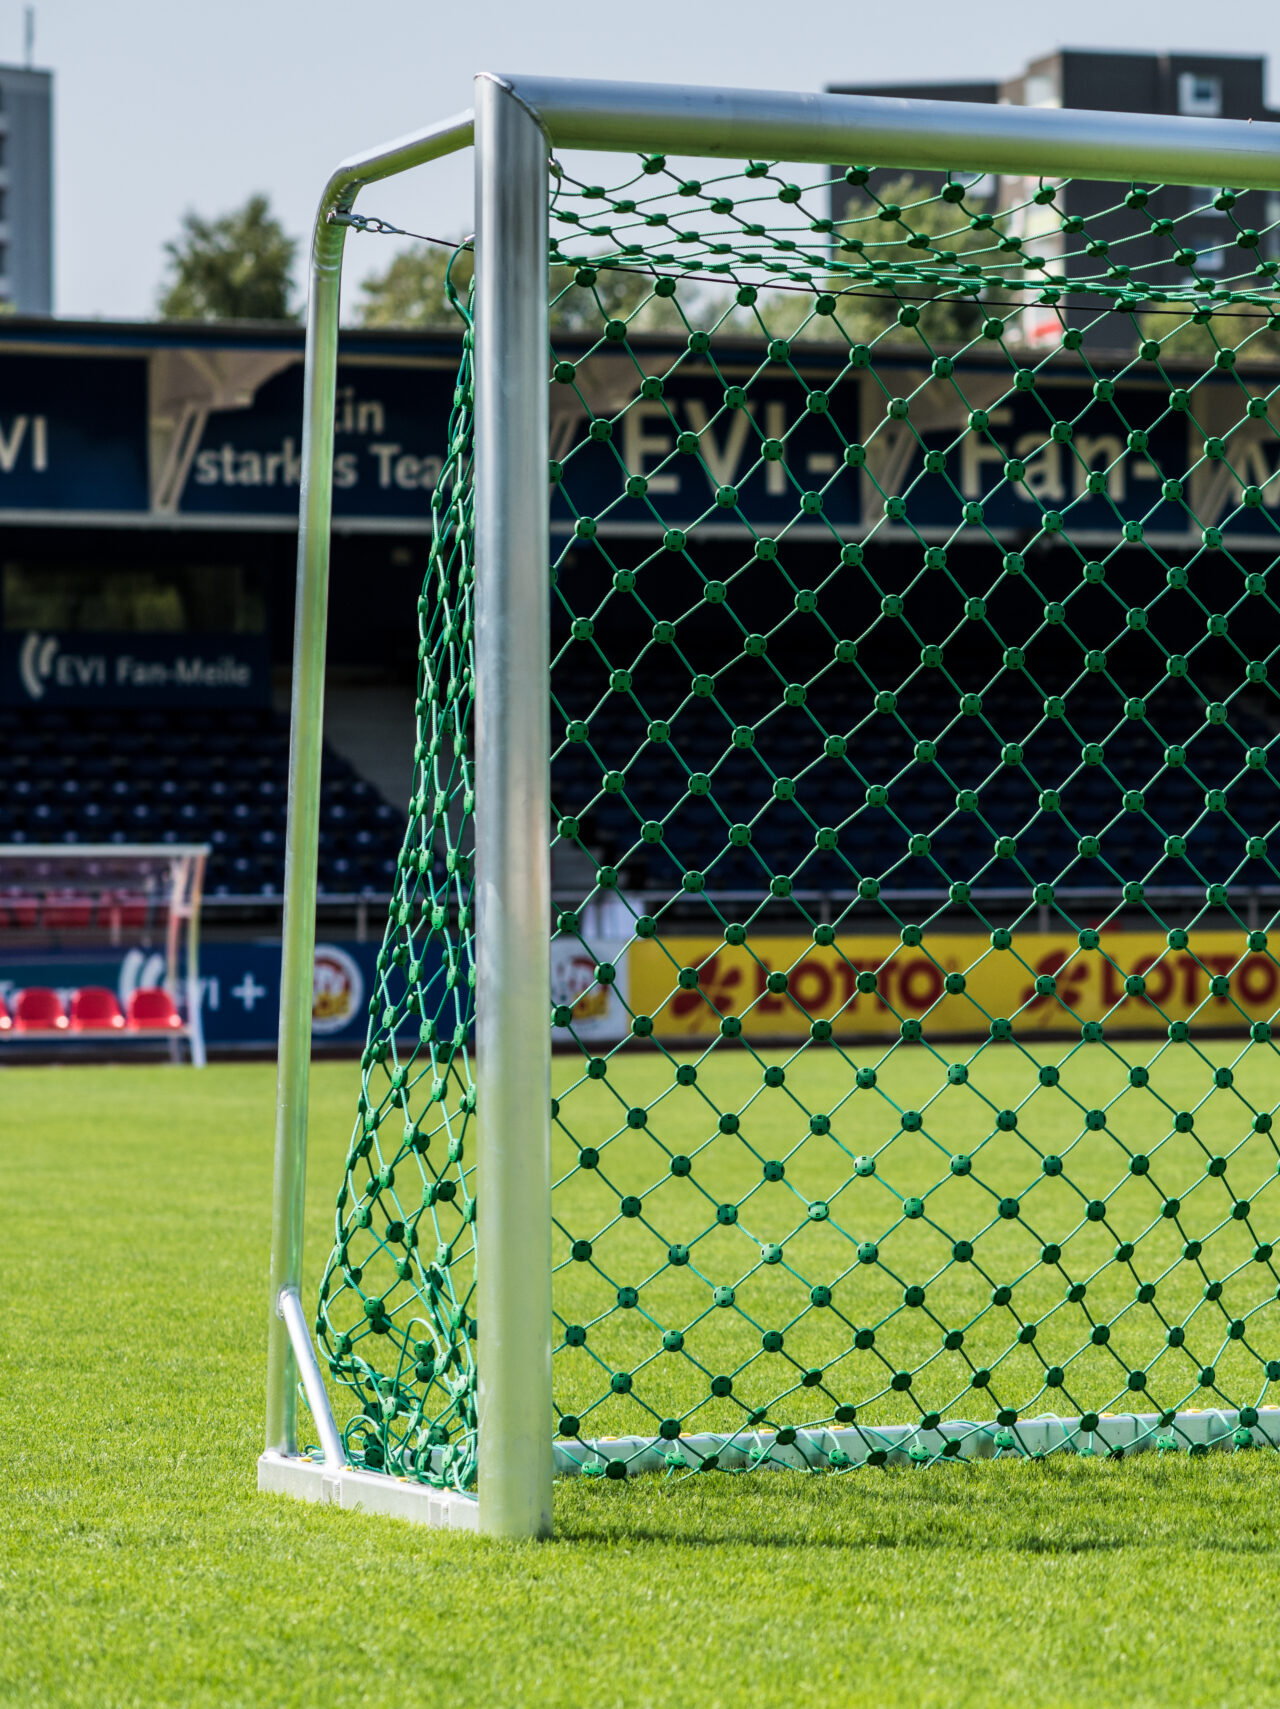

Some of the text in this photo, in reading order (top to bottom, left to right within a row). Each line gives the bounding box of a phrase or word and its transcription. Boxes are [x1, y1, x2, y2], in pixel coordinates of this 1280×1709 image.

[334, 388, 384, 434] in
[0, 414, 48, 472] VI
[194, 438, 358, 488] starks
[57, 655, 106, 687] EVI
[756, 957, 943, 1015] LOTTO
[1102, 953, 1280, 1008] LOTTO
